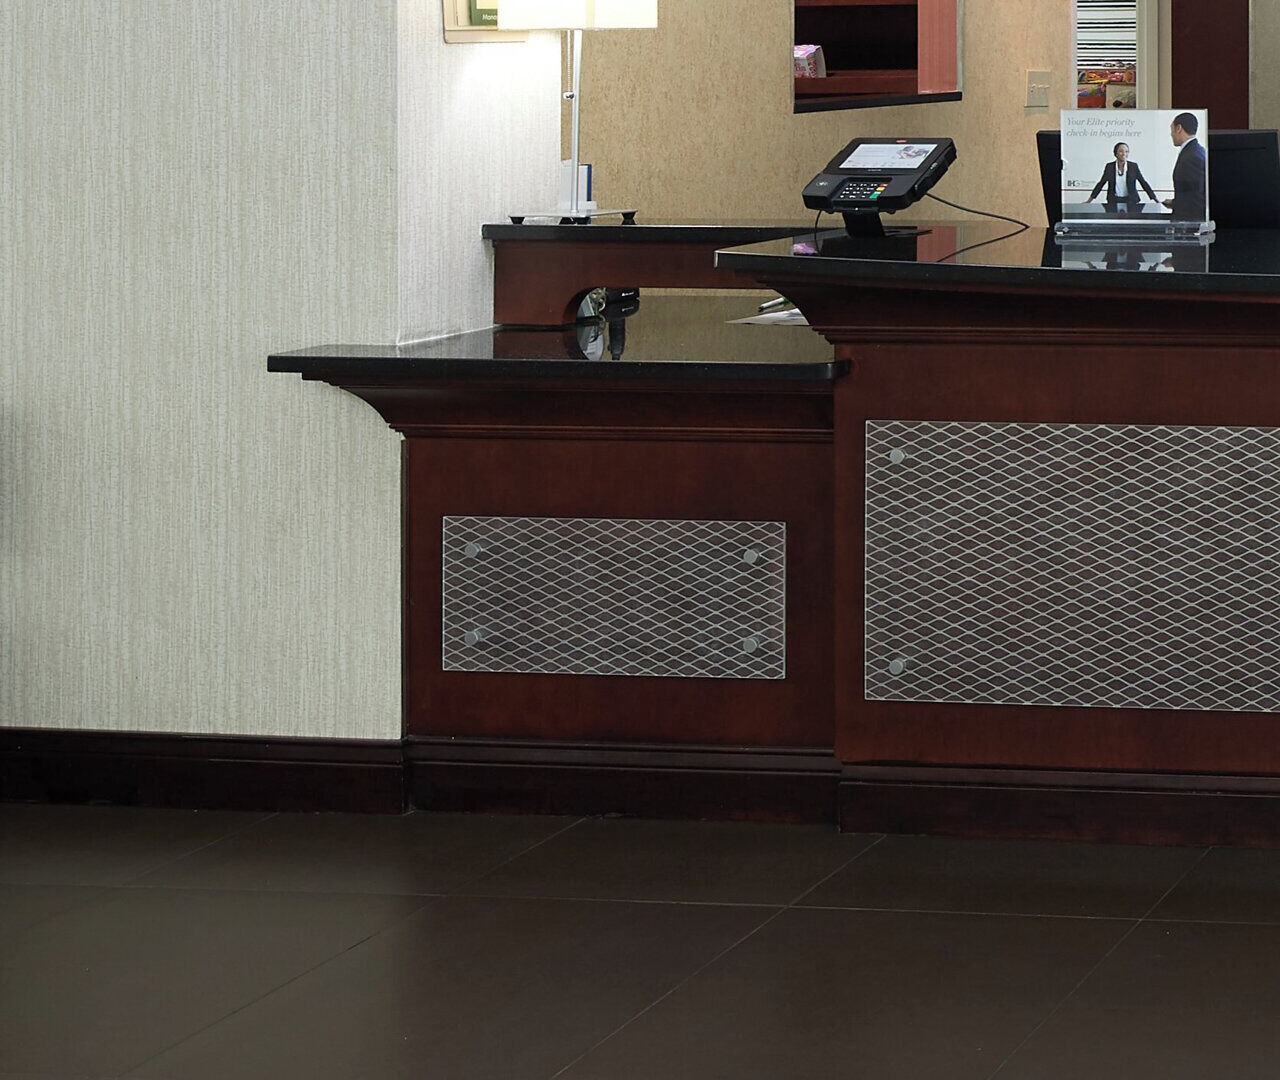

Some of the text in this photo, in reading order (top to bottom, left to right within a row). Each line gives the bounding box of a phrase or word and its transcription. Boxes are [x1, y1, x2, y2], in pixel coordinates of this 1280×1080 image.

[1067, 117, 1135, 127] Your Elite priority
[1099, 129, 1124, 138] begins
[1125, 129, 1142, 137] here
